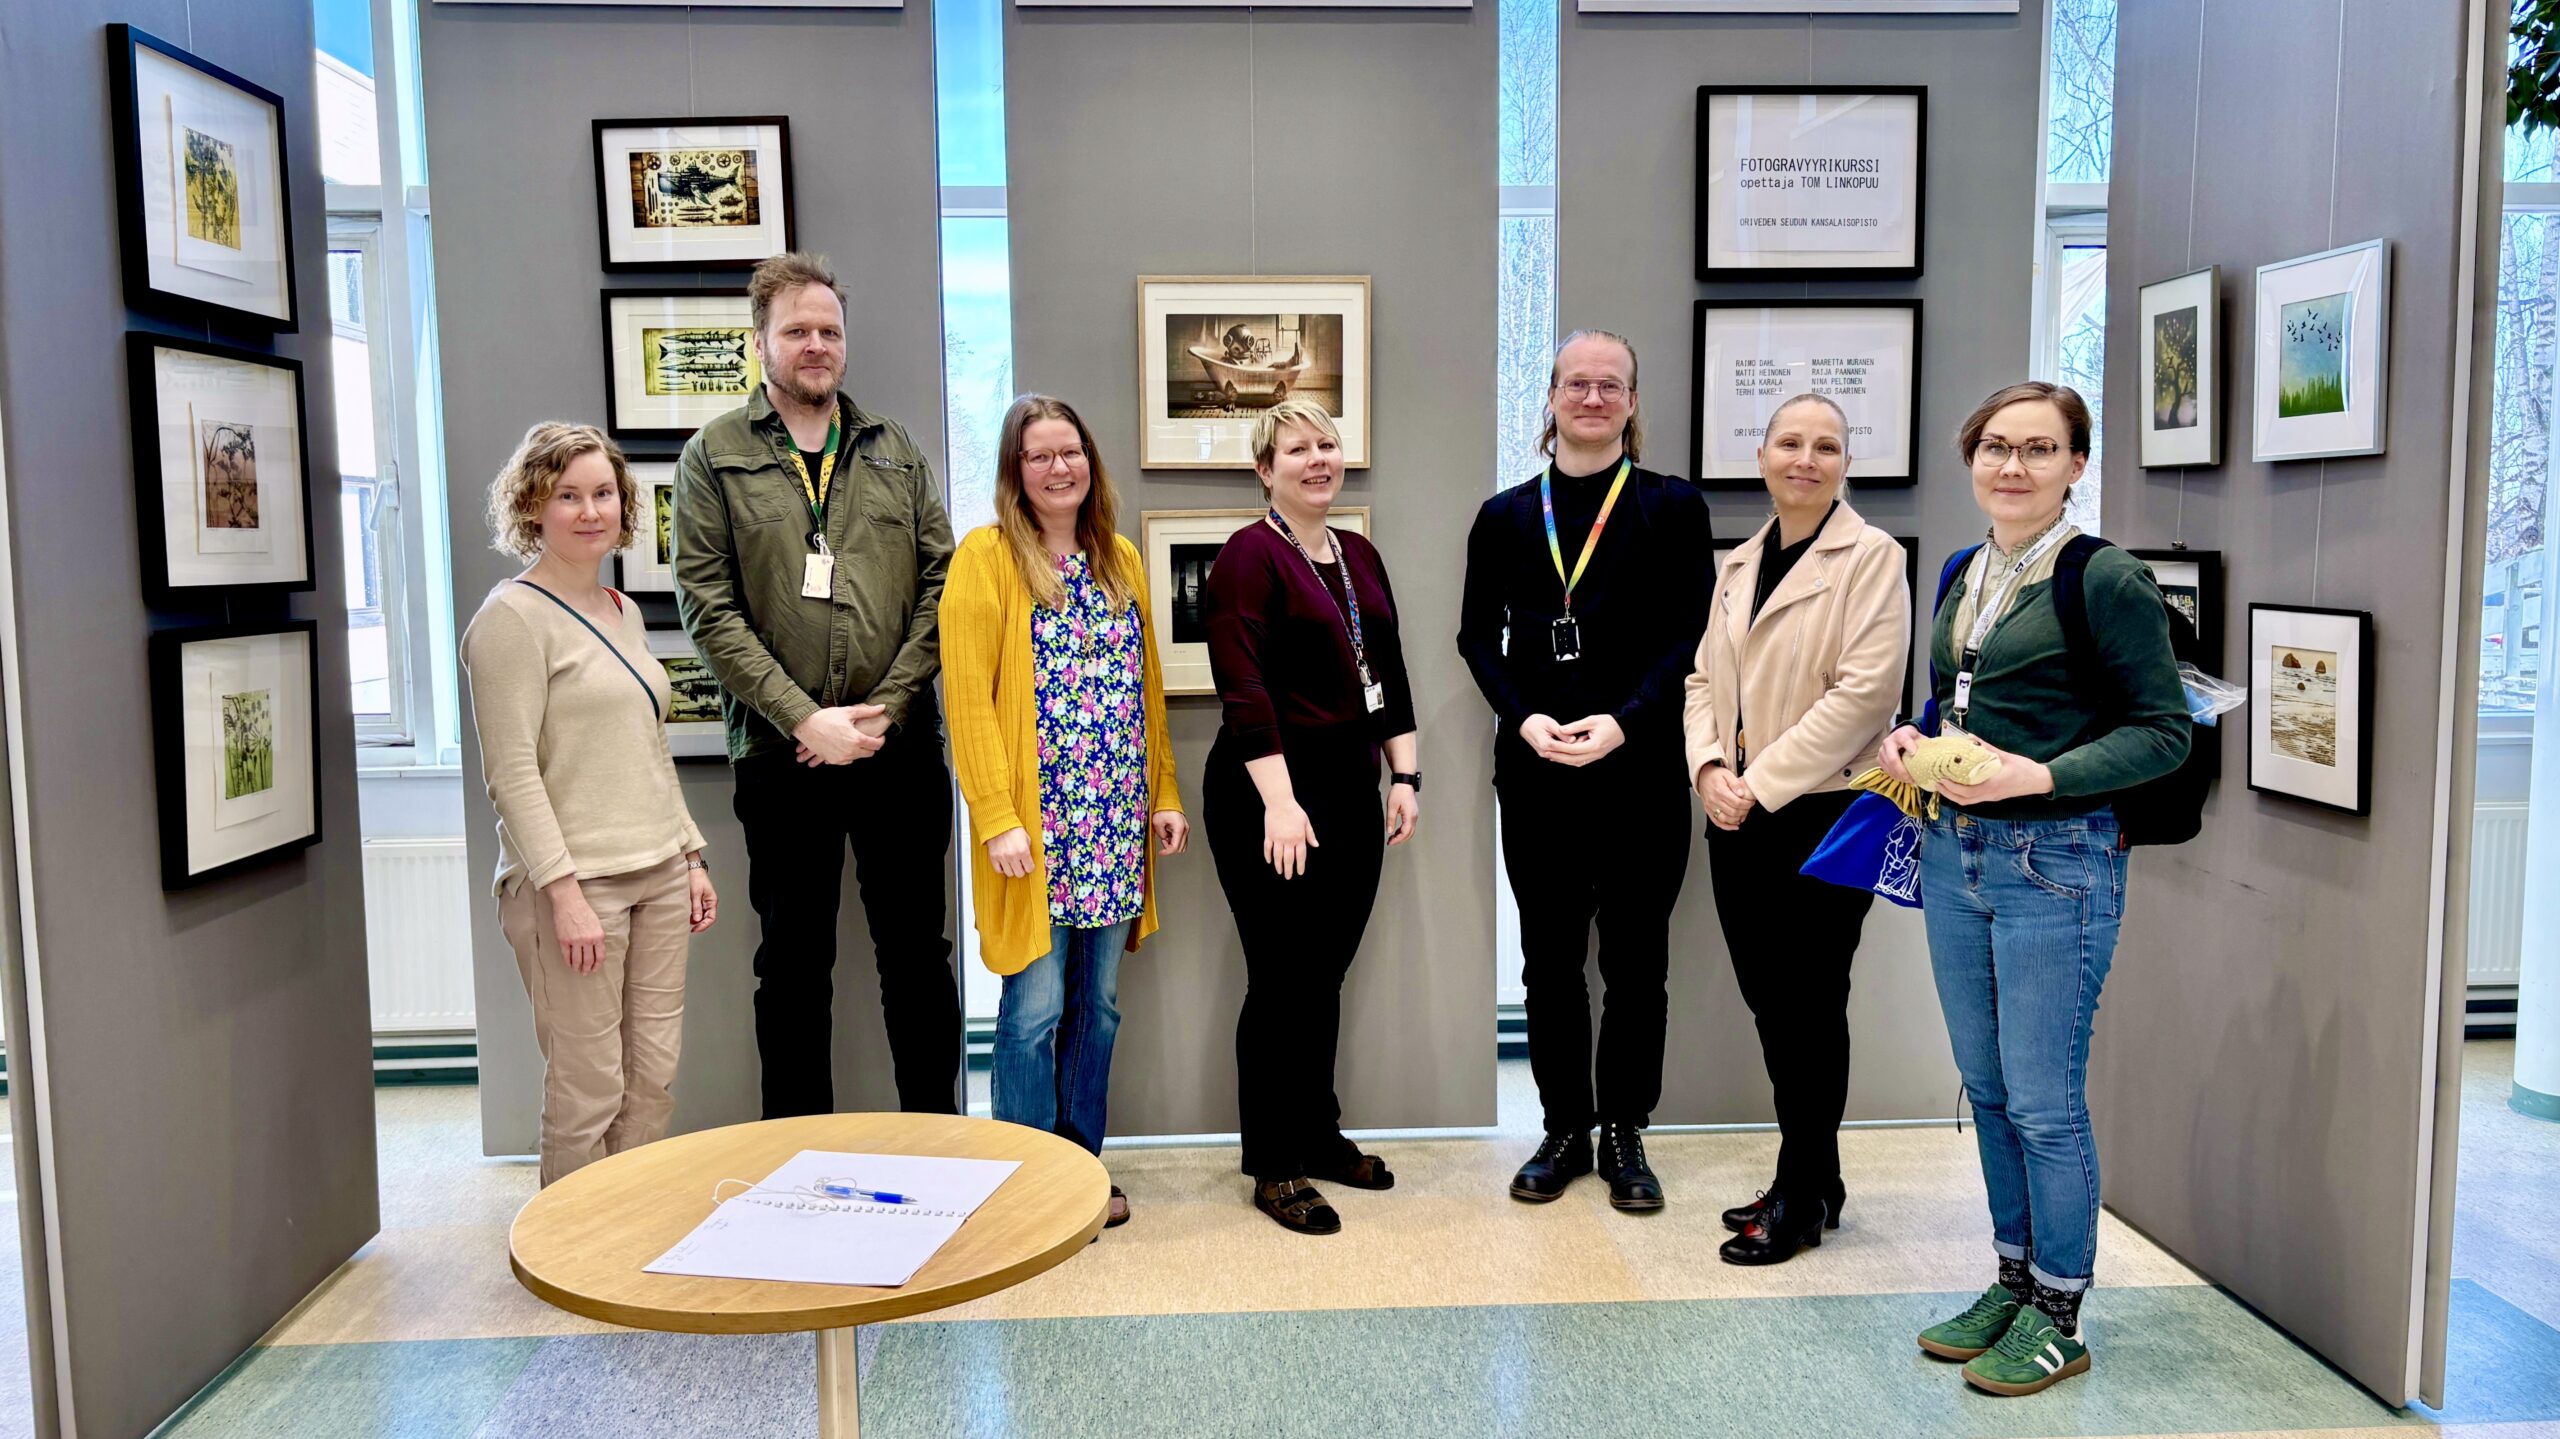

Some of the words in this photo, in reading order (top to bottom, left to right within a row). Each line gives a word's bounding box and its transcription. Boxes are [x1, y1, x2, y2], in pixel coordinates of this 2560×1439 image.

[1740, 157, 1879, 172] FOTOGRAVYYRIKURSSI
[1740, 176, 1794, 189] opettaja
[1801, 176, 1821, 188] TOM
[1826, 176, 1879, 188] LINKOPUU
[1739, 217, 1776, 226] ORIVEDEN
[1780, 217, 1807, 226] SEUDUN
[1811, 218, 1878, 227] KANSALAISOPISTO
[1735, 359, 1756, 367] RAIMO
[1759, 359, 1776, 367] DAHL
[1811, 358, 1844, 366] MAARETTA
[1847, 358, 1875, 366] MURANEN
[1735, 368, 1755, 377] MATTI
[1758, 368, 1791, 376] HEINONEN
[1835, 367, 1867, 375] PAANANEN
[1758, 378, 1783, 386] KARALA
[1831, 377, 1863, 385] PELTONEN
[1735, 388, 1755, 396] TERHI
[1834, 387, 1867, 395] SAARINEN
[1734, 427, 1767, 437] ORIVEDE
